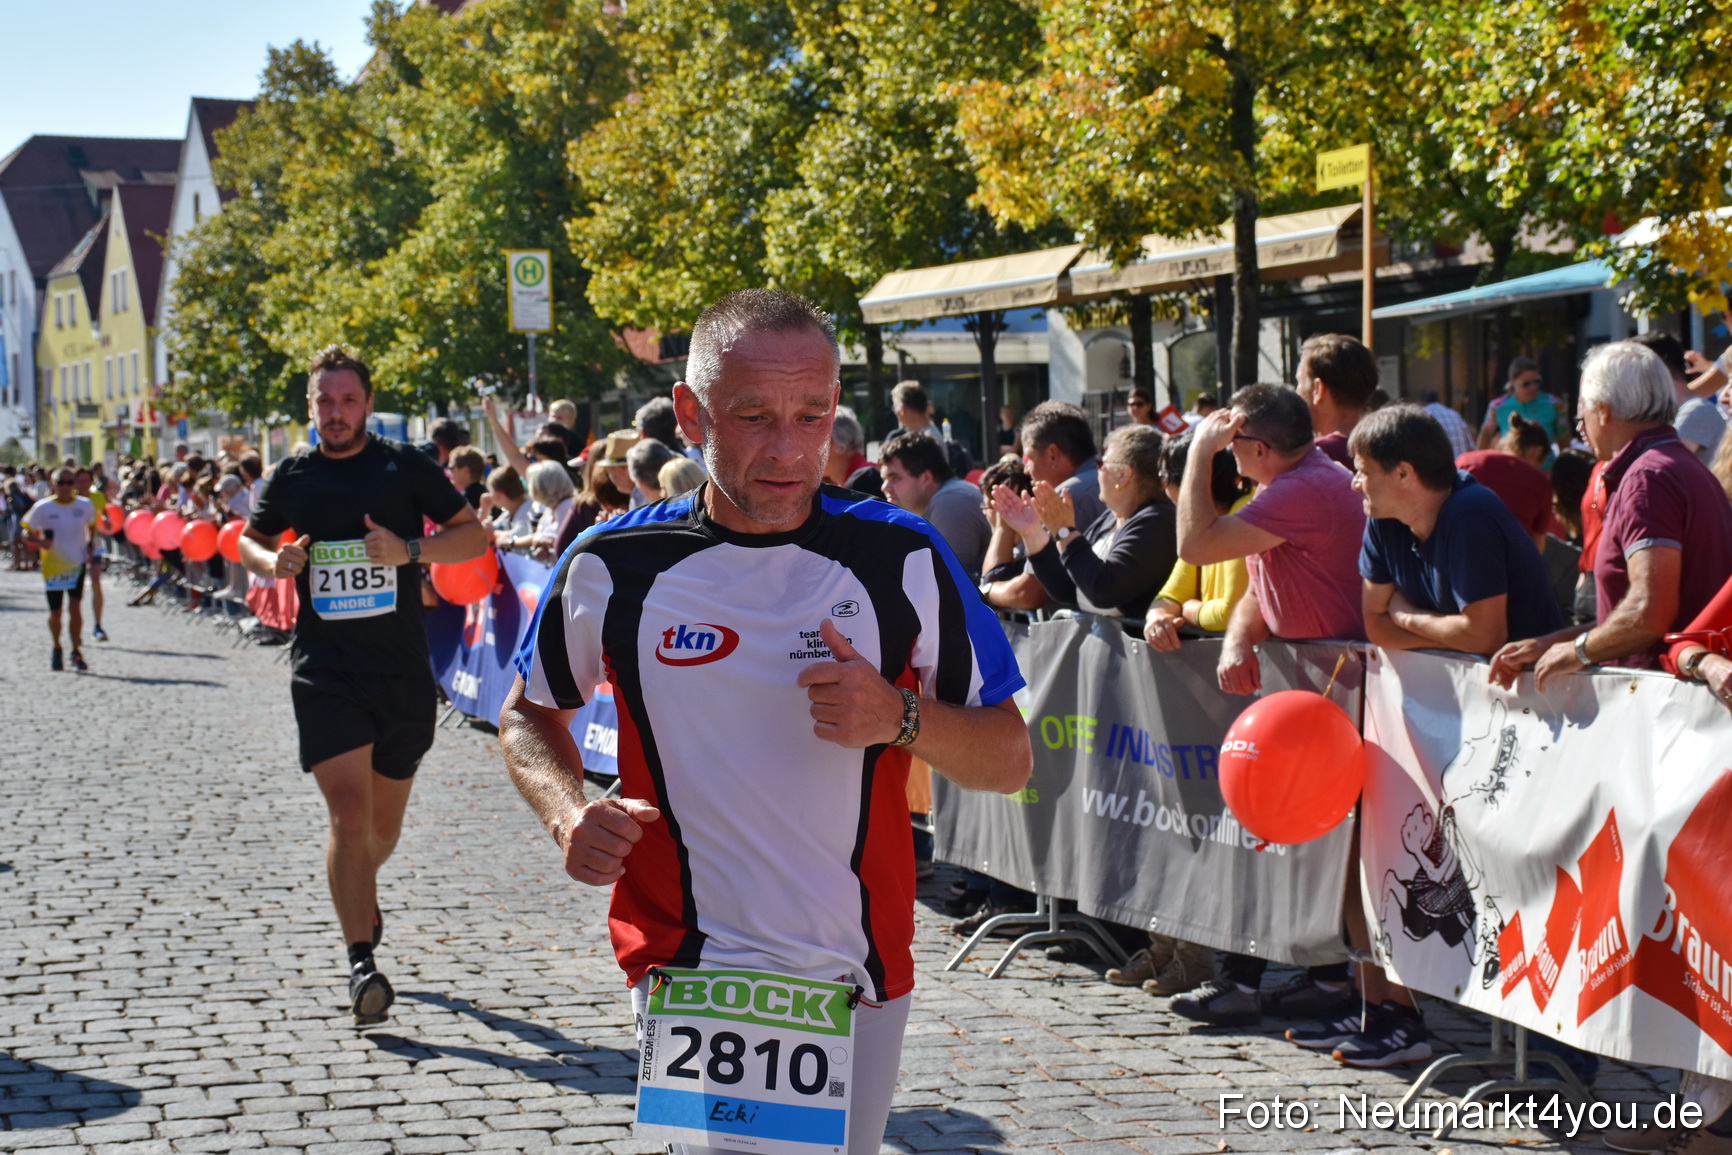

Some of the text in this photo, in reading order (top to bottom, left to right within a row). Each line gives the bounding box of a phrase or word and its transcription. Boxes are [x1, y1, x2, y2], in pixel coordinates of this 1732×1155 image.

[1327, 160, 1364, 177] Toiletten
[523, 263, 537, 280] H
[316, 545, 366, 561] BOC
[318, 566, 386, 593] 2185
[662, 624, 716, 651] tkn
[789, 649, 835, 660] nürnber
[1578, 915, 1623, 989] Braun
[1643, 881, 1732, 1008] Braun
[1590, 953, 1634, 991] Sicher ist sicher
[667, 979, 830, 1023] BOCK
[1682, 971, 1710, 1003] Sicher
[1710, 996, 1722, 1015] ist
[666, 1026, 829, 1096] 2810
[709, 1100, 759, 1124] Ecki
